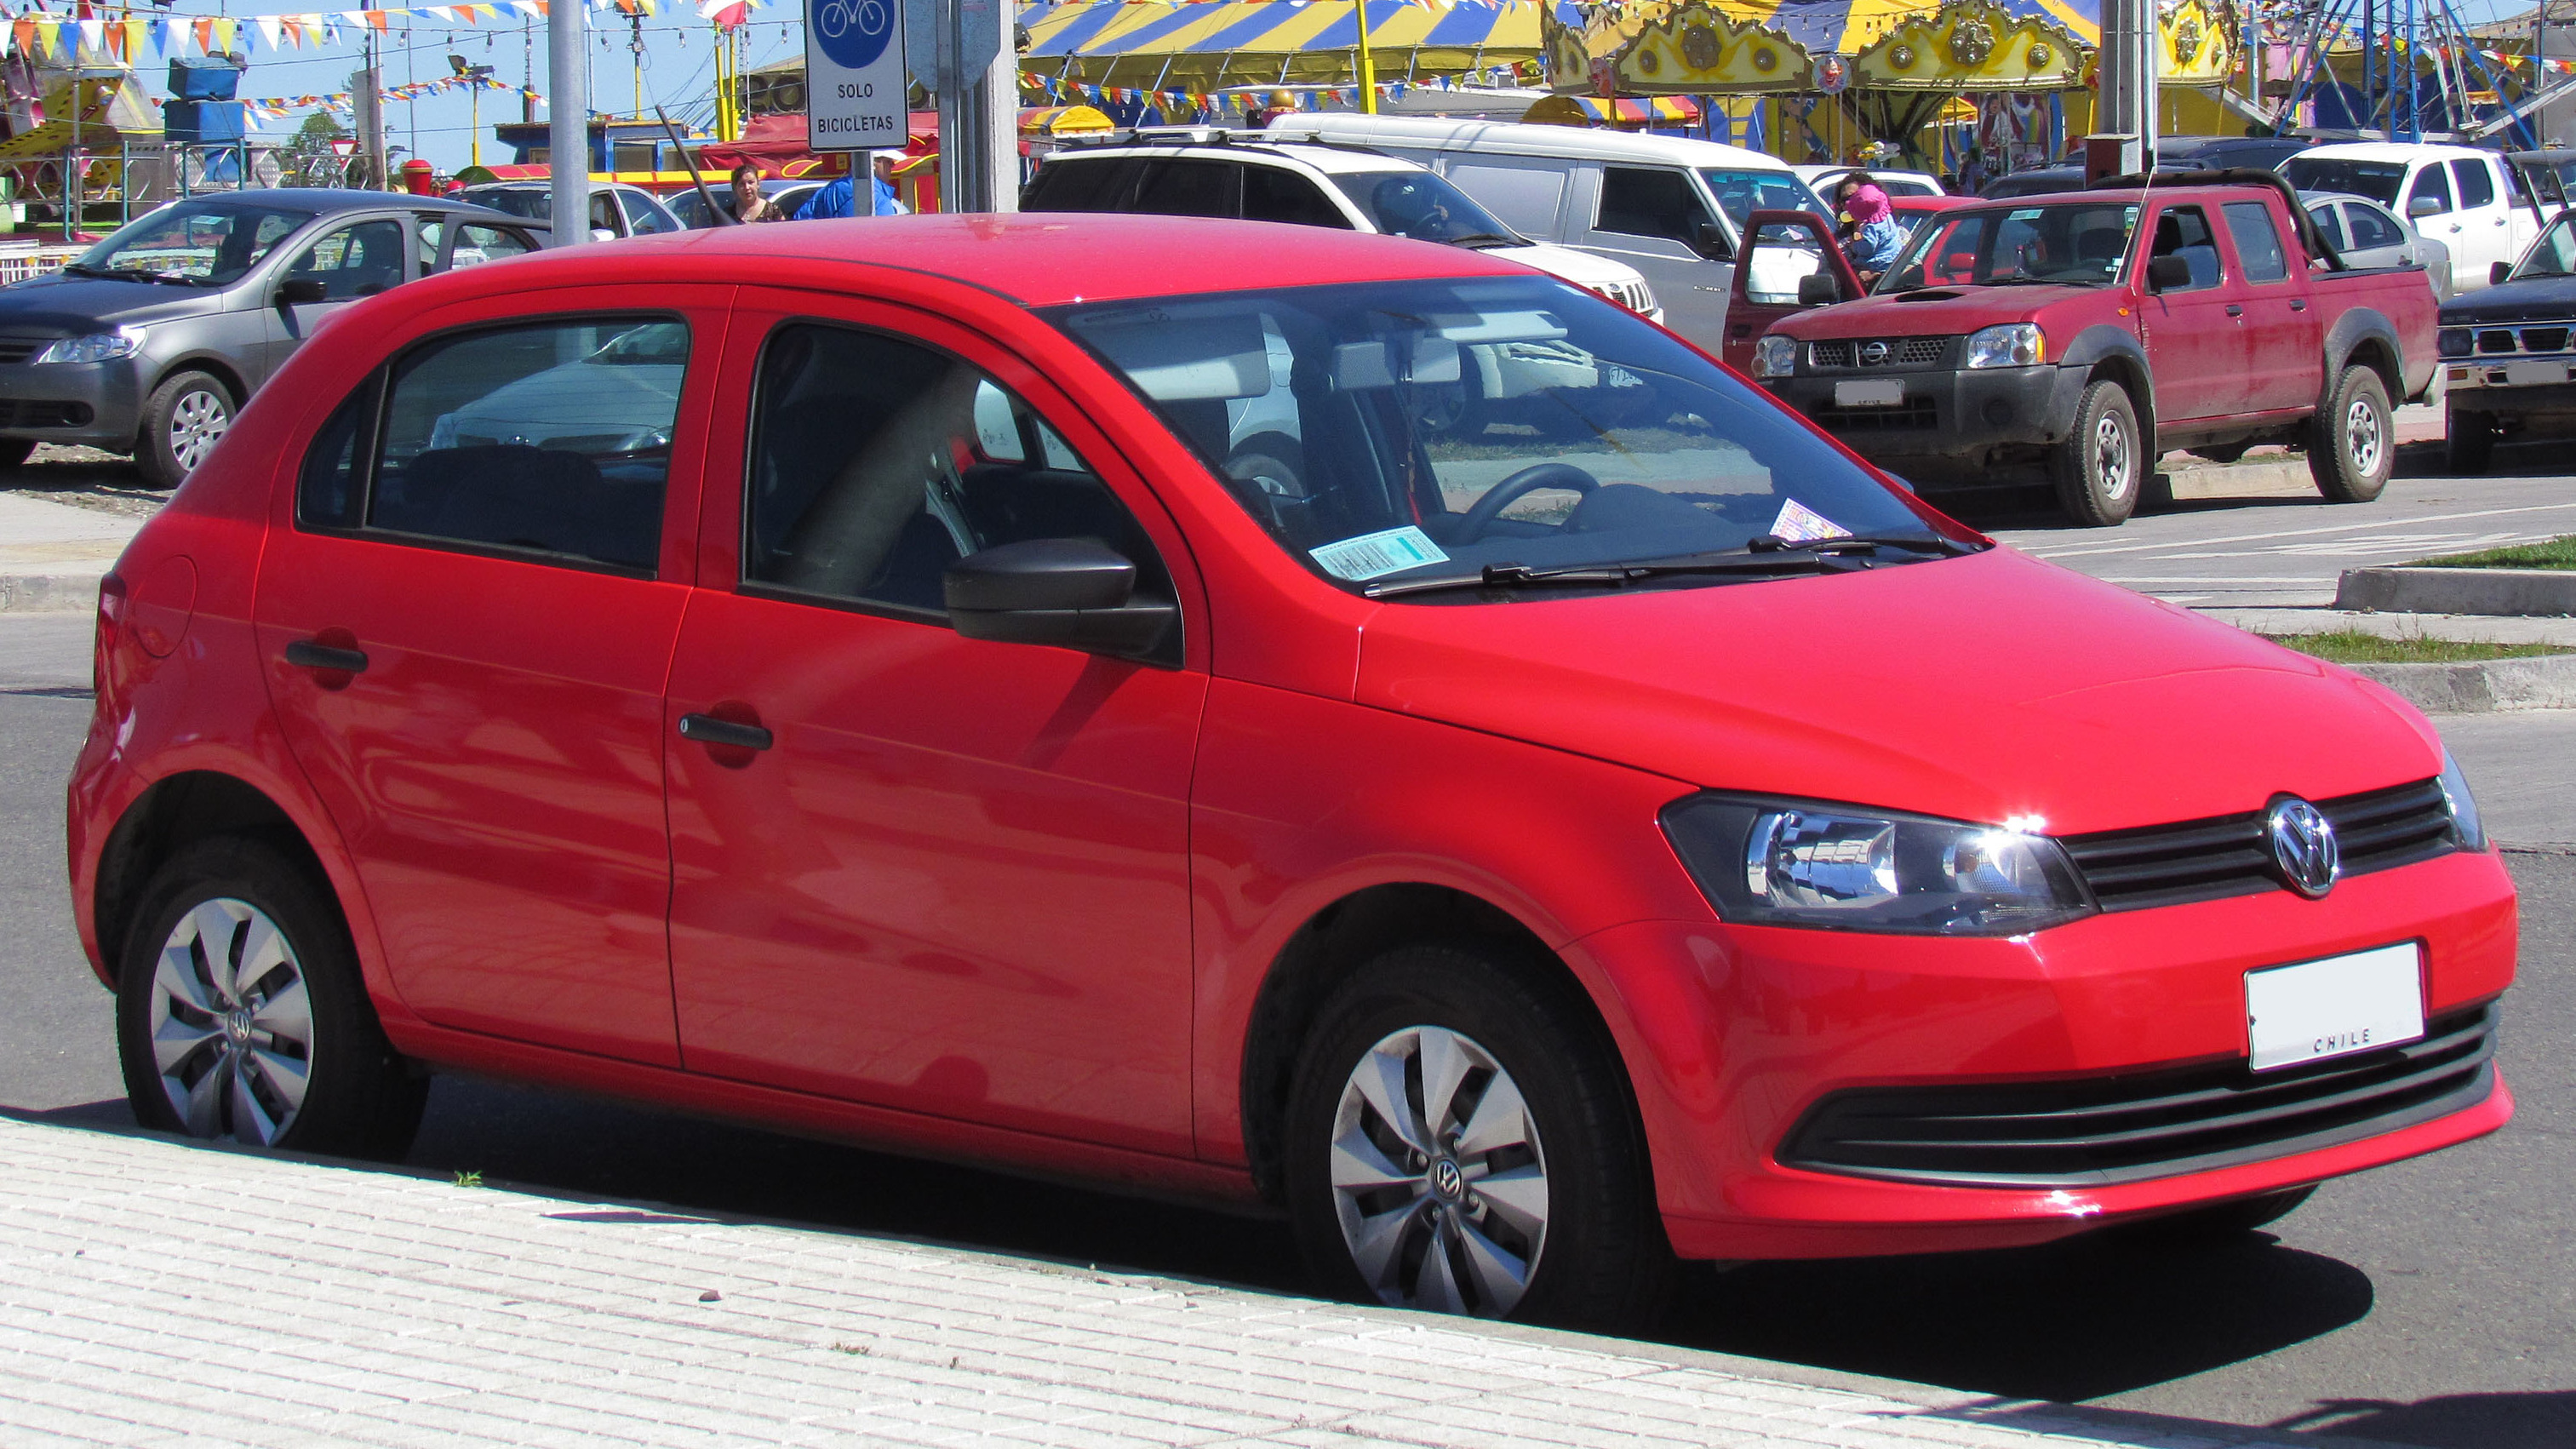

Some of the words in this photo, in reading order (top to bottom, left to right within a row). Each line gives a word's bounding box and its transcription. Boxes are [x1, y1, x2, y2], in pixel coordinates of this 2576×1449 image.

[838, 83, 873, 99] SOLO
[818, 116, 893, 133] BICICLETAS
[2313, 1028, 2370, 1053] CHILE
